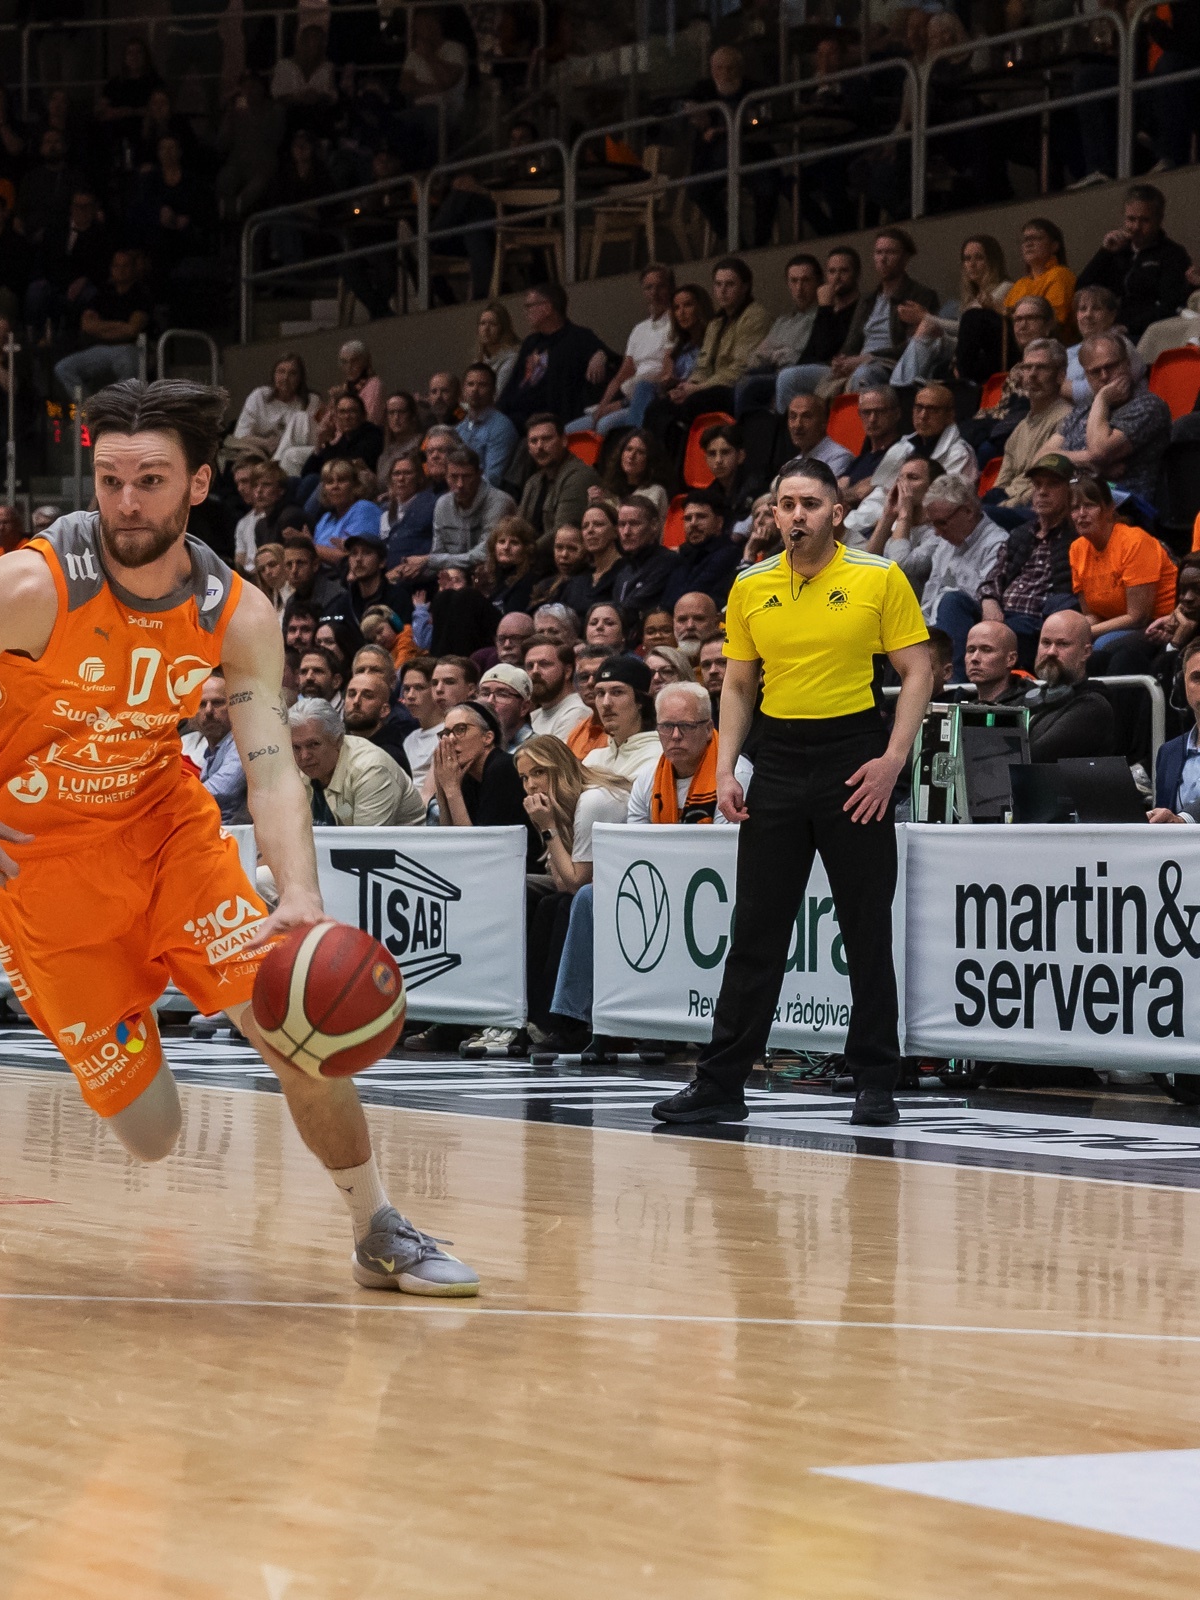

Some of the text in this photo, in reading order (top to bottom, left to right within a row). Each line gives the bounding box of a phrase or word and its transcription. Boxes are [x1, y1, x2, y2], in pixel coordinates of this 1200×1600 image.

[58, 787, 137, 805] FASTIGHETER
[954, 958, 1185, 1038] servera
[86, 1053, 130, 1090] GRUPPEN
